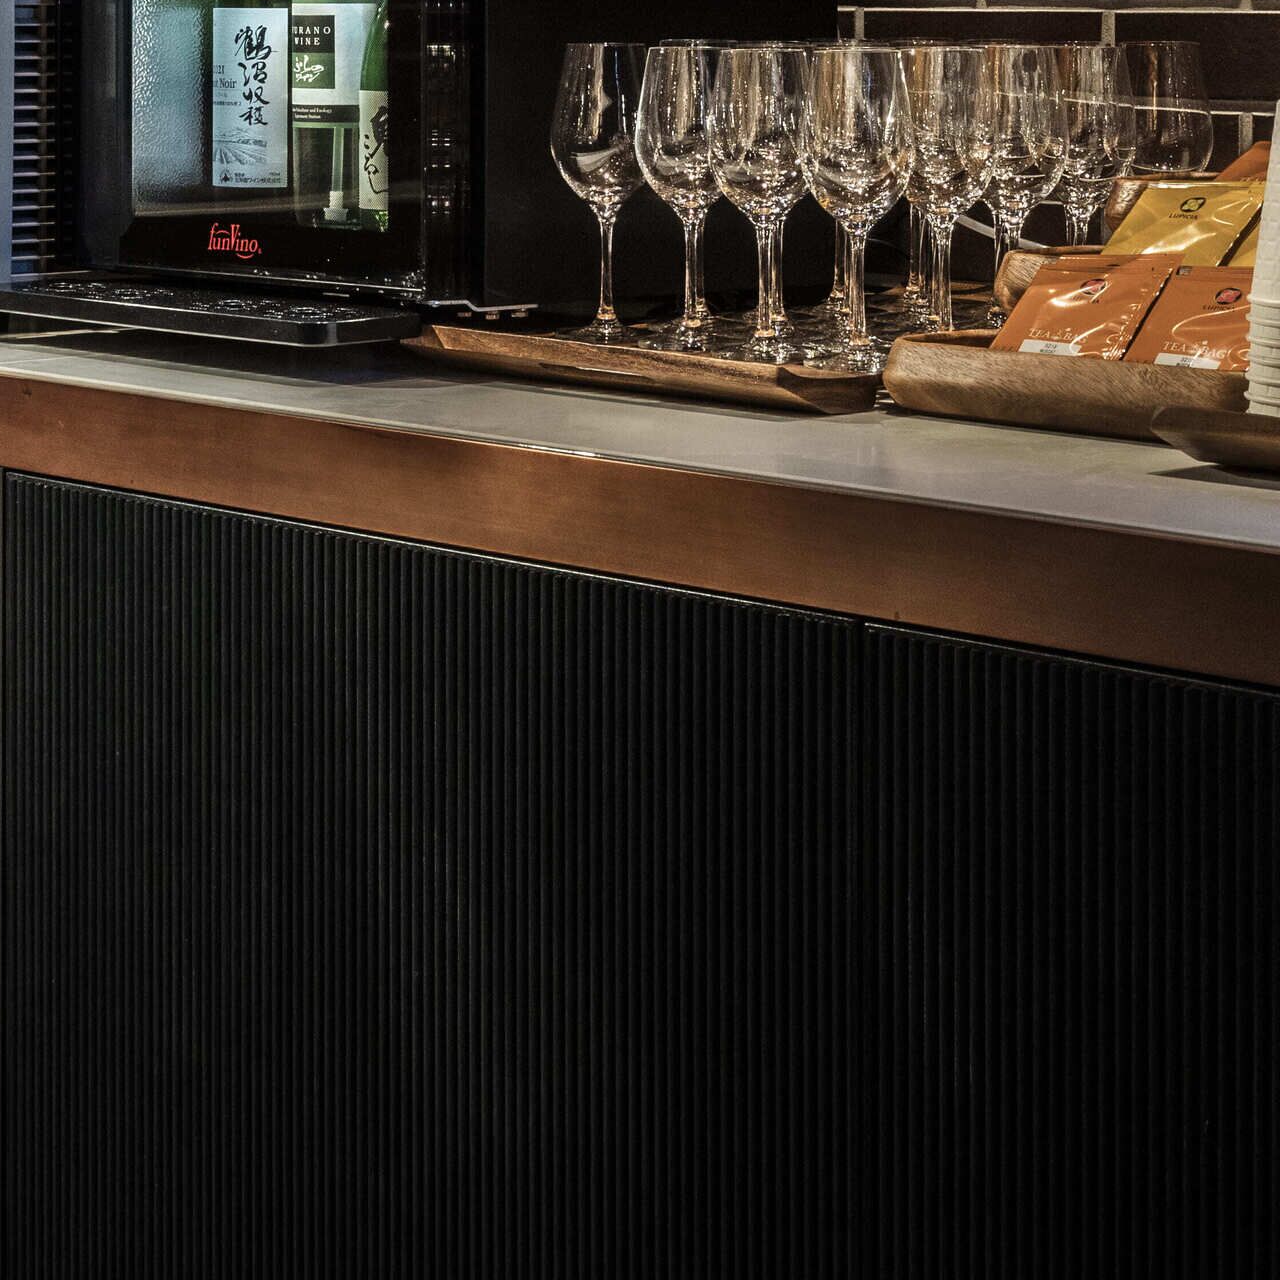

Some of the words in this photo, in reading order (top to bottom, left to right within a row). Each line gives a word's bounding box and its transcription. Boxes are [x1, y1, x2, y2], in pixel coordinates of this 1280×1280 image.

[292, 25, 331, 35] URANO
[294, 37, 321, 46] WINE
[220, 78, 237, 89] Noir
[207, 222, 259, 256] funVino
[1028, 328, 1051, 338] TEA
[1162, 341, 1186, 352] TEA
